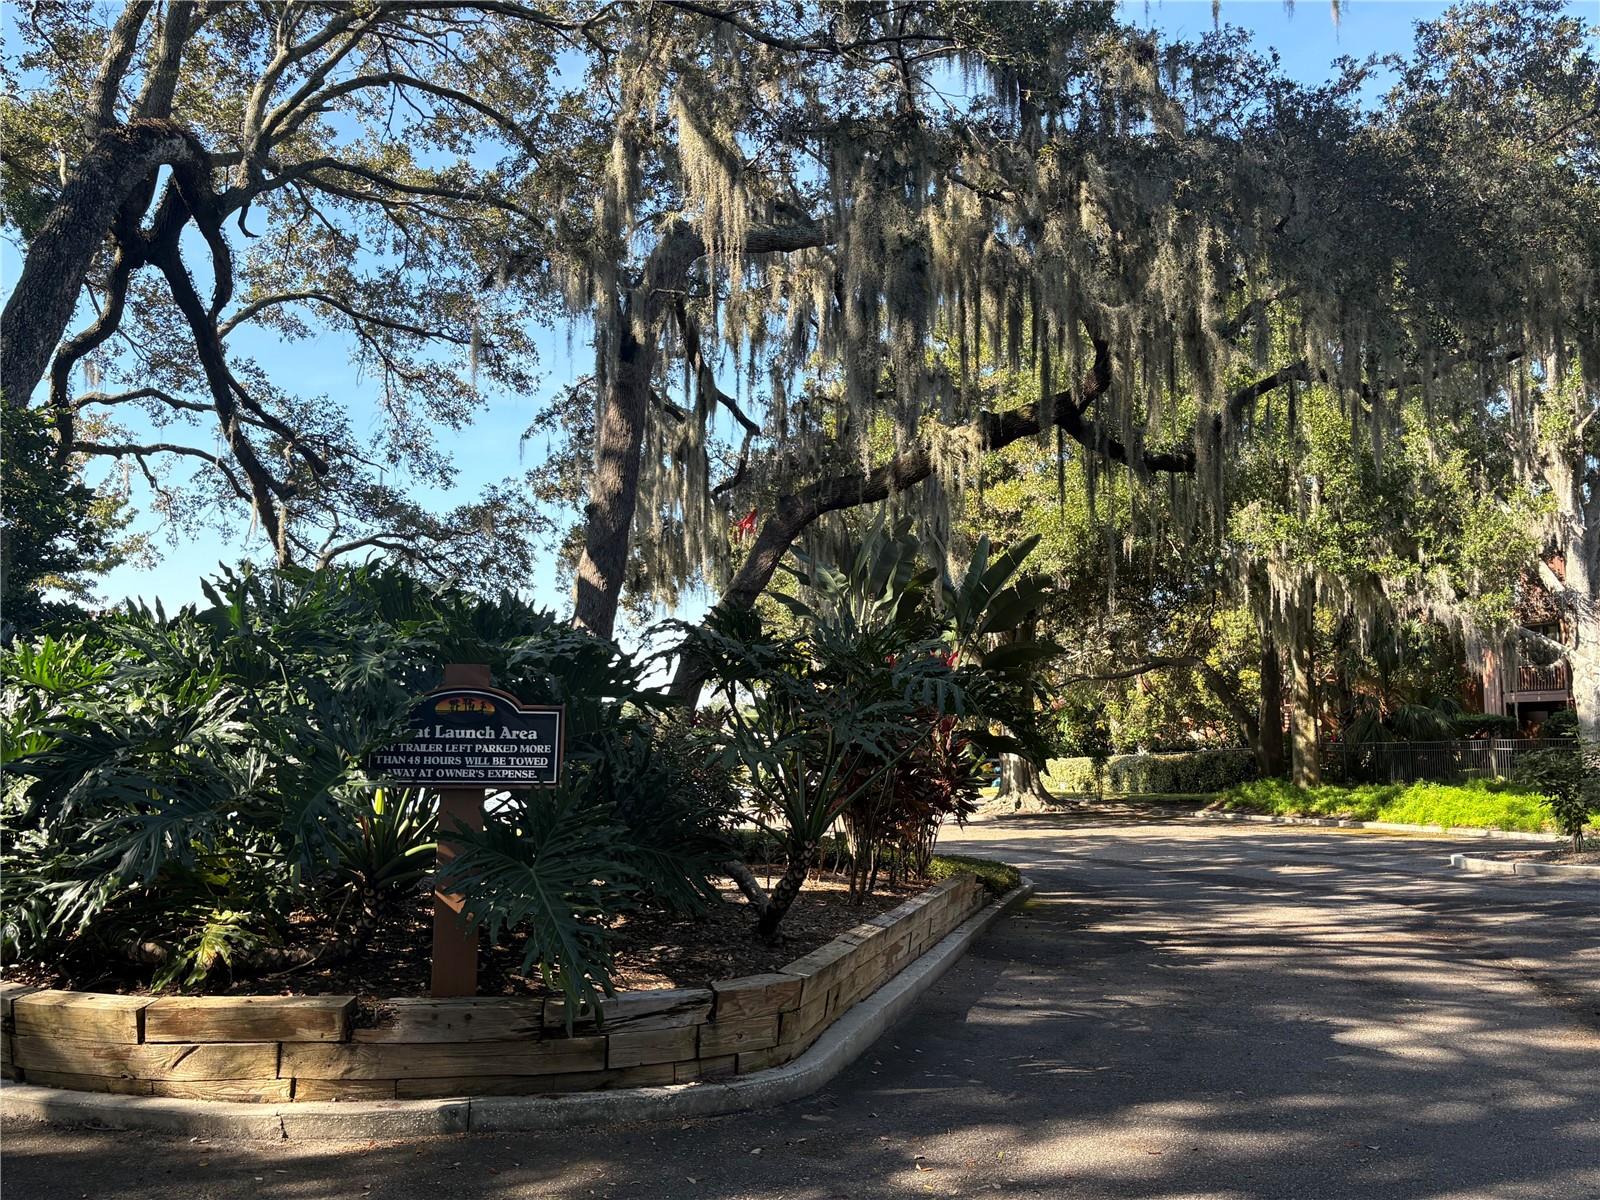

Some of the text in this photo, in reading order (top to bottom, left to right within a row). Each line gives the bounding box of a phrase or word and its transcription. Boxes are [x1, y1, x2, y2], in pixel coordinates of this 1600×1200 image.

[435, 724, 496, 739] Launch
[499, 725, 538, 740] Area
[397, 743, 443, 753] TRAILER
[445, 743, 473, 753] LEFT
[475, 743, 518, 753] PARKED
[519, 744, 552, 754] MORE
[375, 755, 549, 767] THAN 48 HOURS WILL BE TOWED
[418, 768, 434, 778] AT
[435, 768, 485, 779] OWNER'S
[487, 769, 538, 779] EXPENSE.
